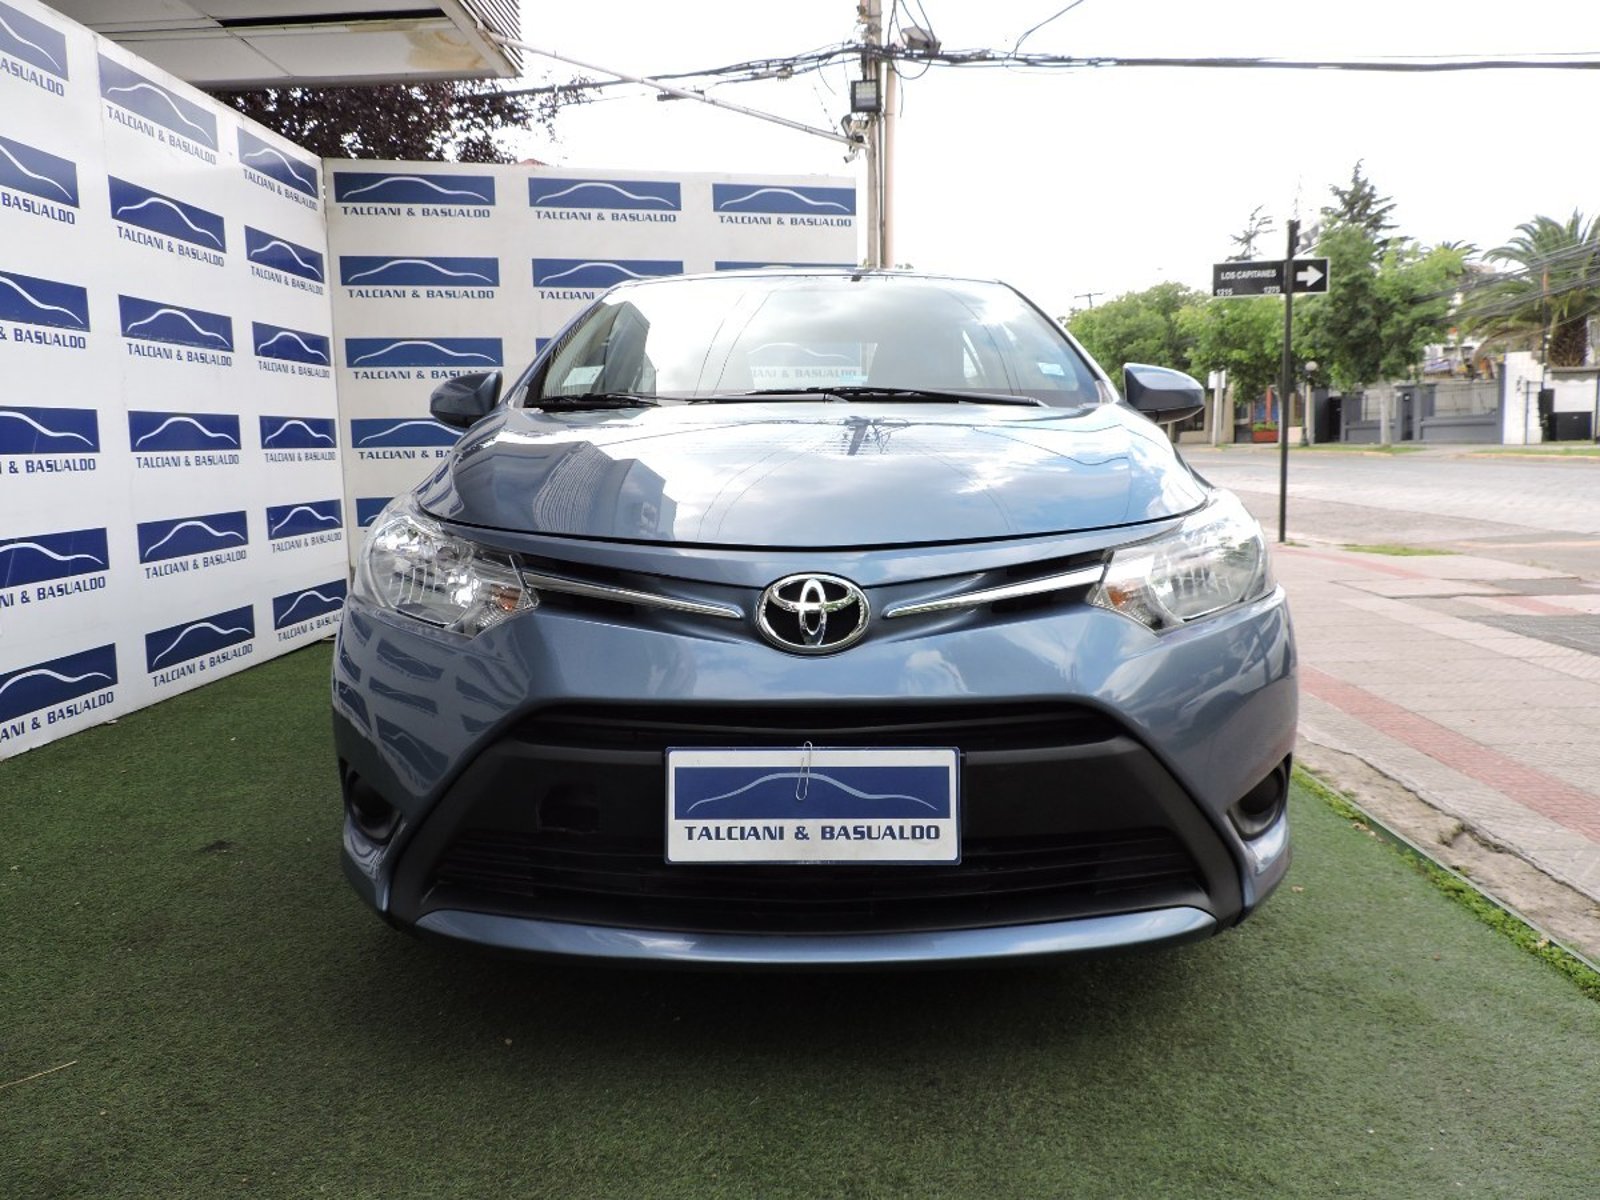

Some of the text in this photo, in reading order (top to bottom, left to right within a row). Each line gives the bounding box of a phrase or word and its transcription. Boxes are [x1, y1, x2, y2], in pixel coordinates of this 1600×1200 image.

[106, 104, 217, 165] TALCIANI & BASUALDO
[243, 168, 318, 211] TALCIANI & BASUALDO
[1, 191, 76, 225] BASUALDO
[341, 206, 490, 218] TALCIANI & BASUALDO
[535, 210, 677, 223] TALCIANI & BASUALDO
[719, 215, 852, 227] TALCIANI & BASUALDO
[117, 225, 224, 267] TALCIANI & BASUALDO
[250, 265, 324, 295] TALCIANI & BASUALDO
[348, 289, 494, 299] TALCIANI & BASUALDO
[538, 290, 595, 300] TALCIANI
[14, 328, 86, 349] BASUALDO
[127, 343, 232, 367] TALCIANI & BASUALDO
[258, 360, 330, 378] TALCIANI & BASUALDO
[353, 371, 411, 380] TALCIANI
[416, 370, 425, 379] &
[136, 454, 239, 469] TALCIANI & BASUALDO
[265, 452, 295, 463] TALCIANI
[304, 451, 336, 461] BASUALDO
[359, 451, 416, 460] TALCIANI
[421, 450, 429, 459] &
[9, 460, 19, 474] &
[25, 458, 96, 473] BASUALDO
[271, 541, 302, 553] TALCIANI
[311, 531, 342, 546] BASUALDO
[145, 549, 247, 579] TALCIANI & BASUALDO
[20, 590, 31, 604] &
[37, 576, 106, 601] BASUALDO
[278, 625, 308, 641] TALCIANI
[153, 643, 253, 687] TALCIANI & BASUALDO
[31, 691, 114, 730] & BASUALDO
[684, 825, 941, 841] TALCIANI & BASUALDO
